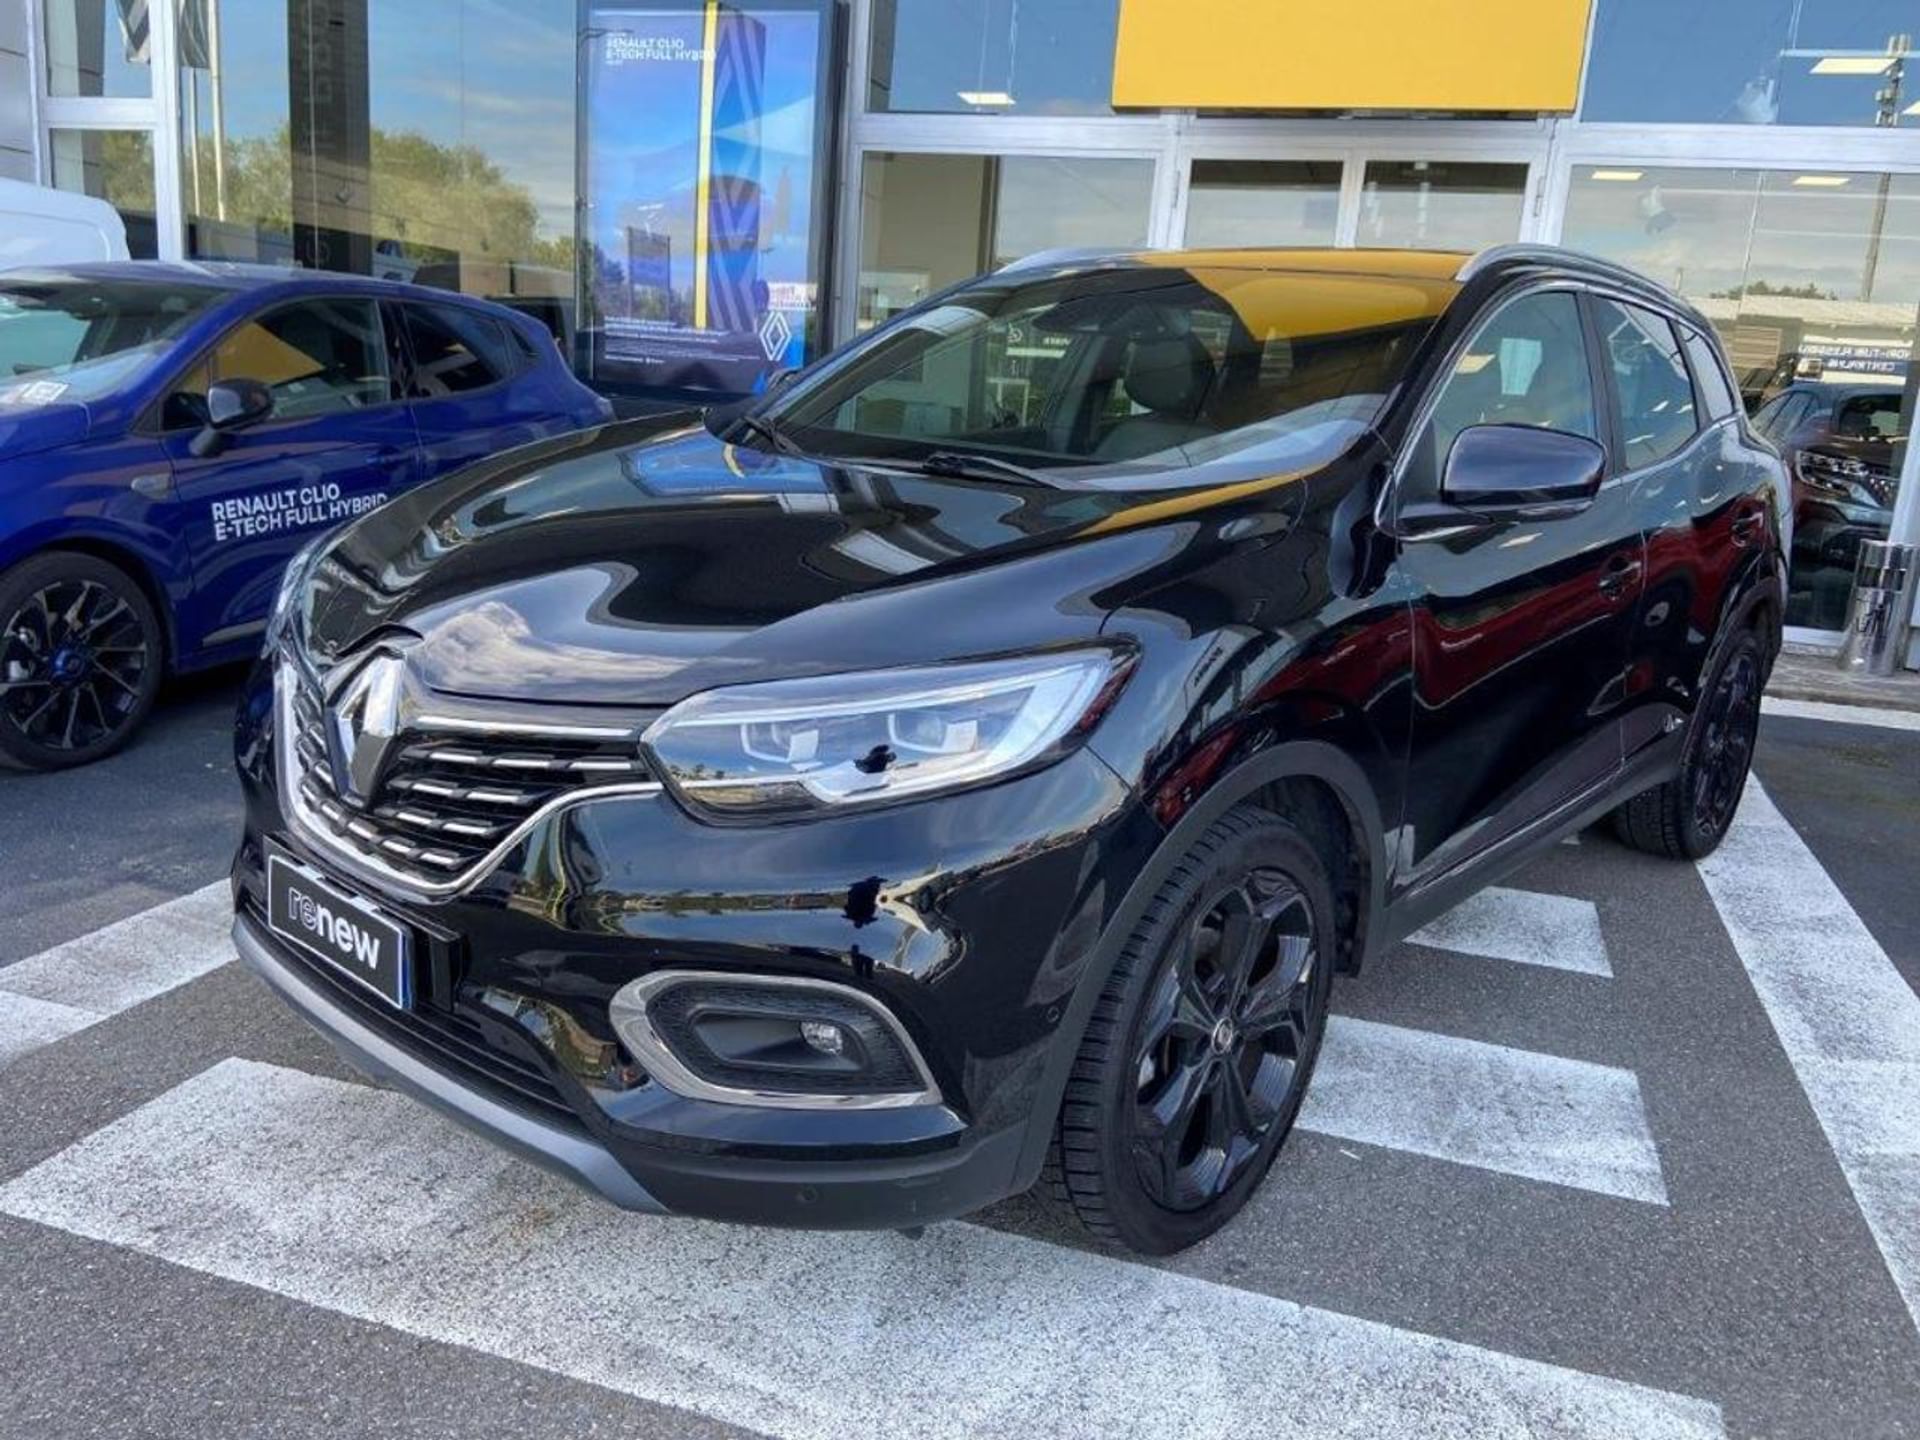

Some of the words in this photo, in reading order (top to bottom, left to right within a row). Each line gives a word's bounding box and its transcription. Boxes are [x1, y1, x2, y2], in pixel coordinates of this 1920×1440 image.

[606, 37, 655, 48] RENAULT
[657, 38, 684, 49] CLIO
[606, 48, 644, 60] E-TECH
[645, 49, 672, 60] FULL
[211, 490, 298, 521] RENAULT
[300, 483, 340, 506] CLIO
[214, 512, 282, 541] E-TECH
[285, 507, 327, 528] FULL
[287, 886, 381, 970] renew
